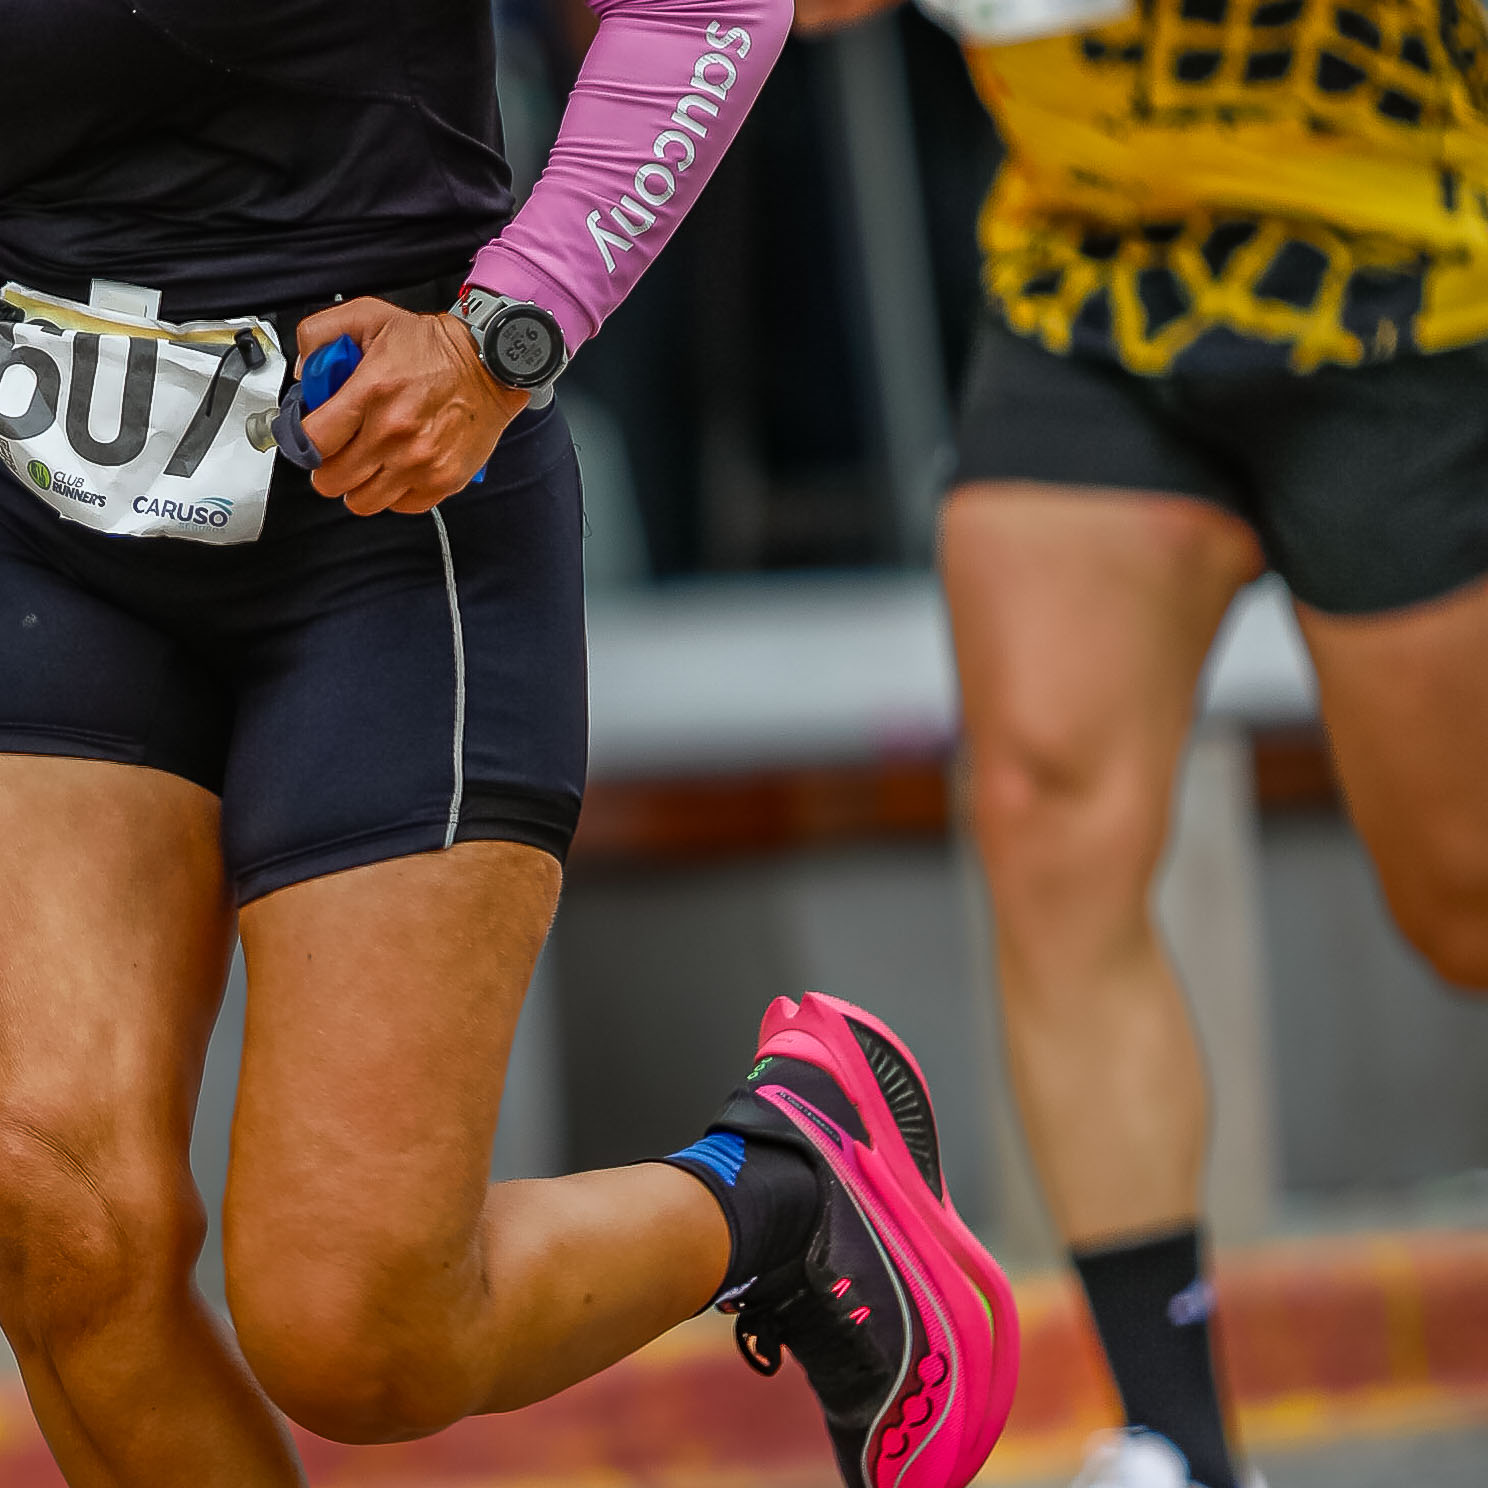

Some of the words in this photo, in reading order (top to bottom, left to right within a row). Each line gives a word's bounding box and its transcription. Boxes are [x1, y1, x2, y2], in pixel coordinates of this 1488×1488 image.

[585, 20, 752, 274] saucony
[52, 480, 107, 508] RUNNER'S
[53, 471, 85, 488] CLUB
[132, 495, 229, 528] CARUSO
